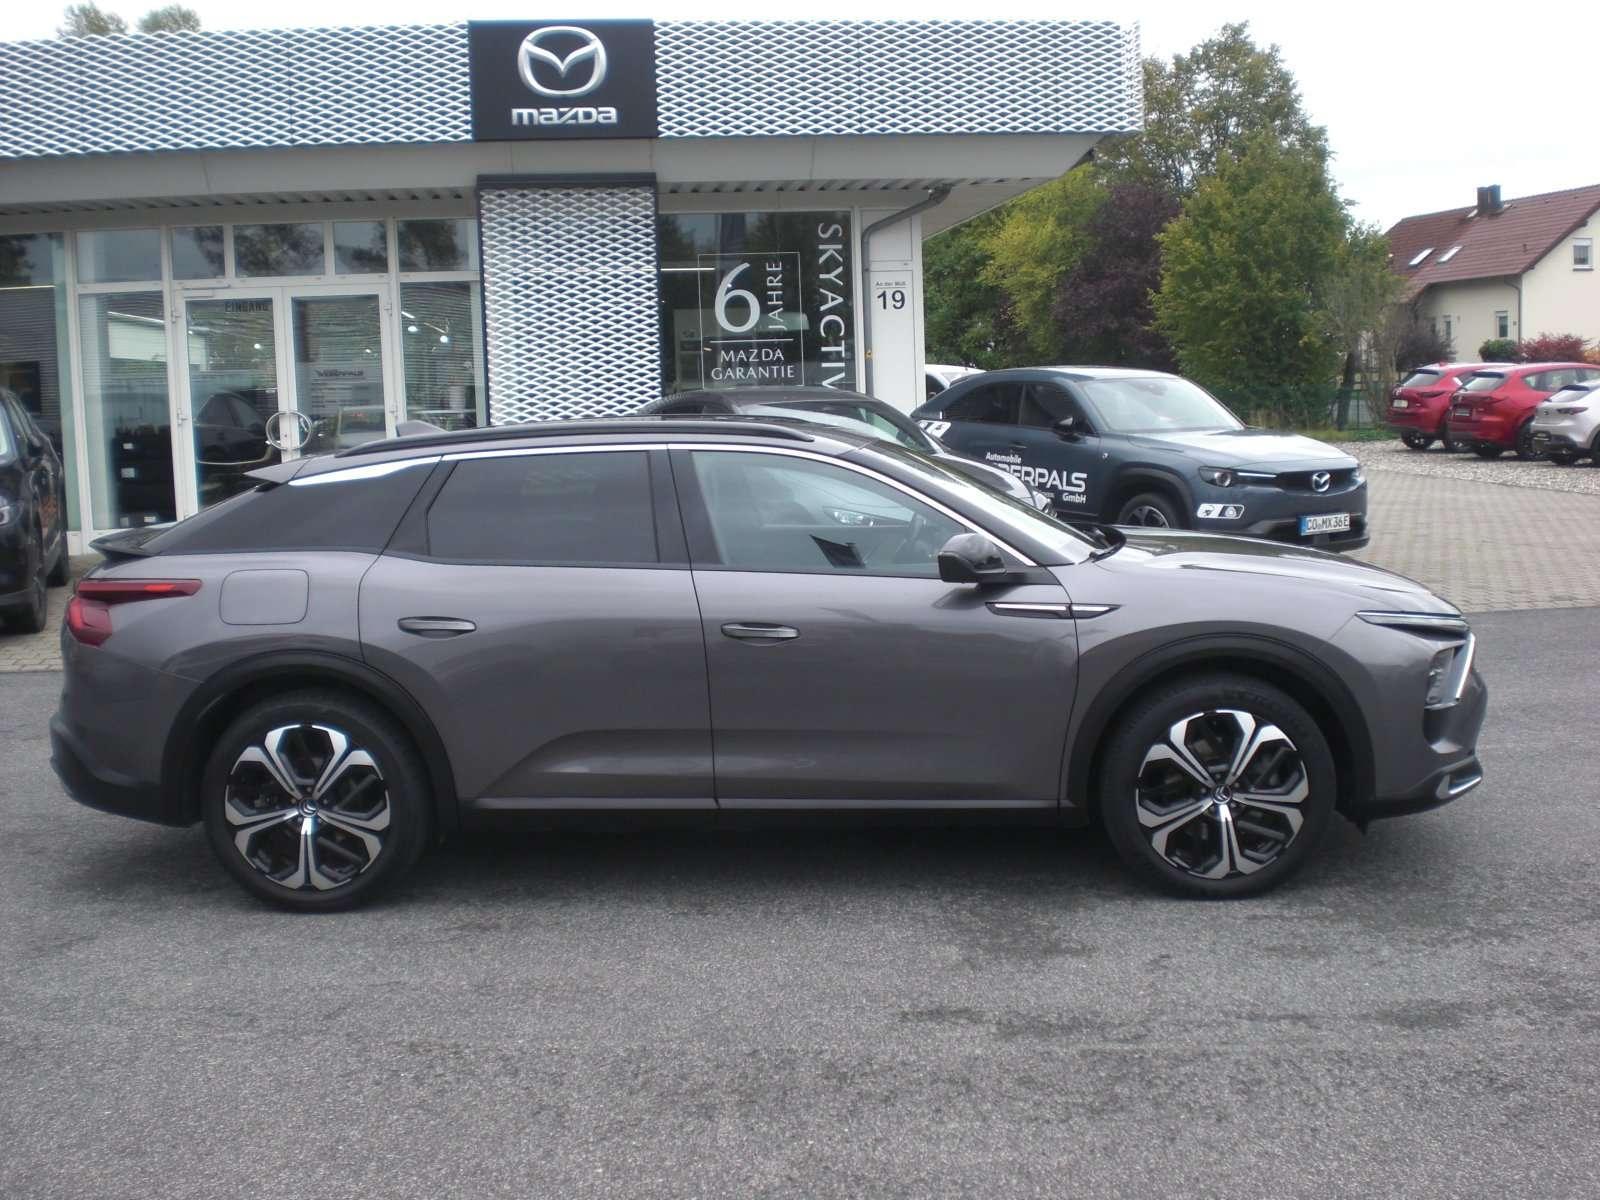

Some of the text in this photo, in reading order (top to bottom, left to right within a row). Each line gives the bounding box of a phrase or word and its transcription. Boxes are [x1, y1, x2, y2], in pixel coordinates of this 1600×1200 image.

[511, 106, 618, 126] mazda
[714, 262, 760, 333] 6
[766, 261, 788, 331] JAHRE
[818, 222, 845, 390] SKYACTIV
[877, 290, 906, 310] 19
[720, 348, 785, 363] MAZDA
[711, 365, 796, 381] GARANTIE
[986, 451, 1022, 464] Automobile
[994, 463, 1088, 493] ERPALS
[1062, 492, 1087, 505] GmbH
